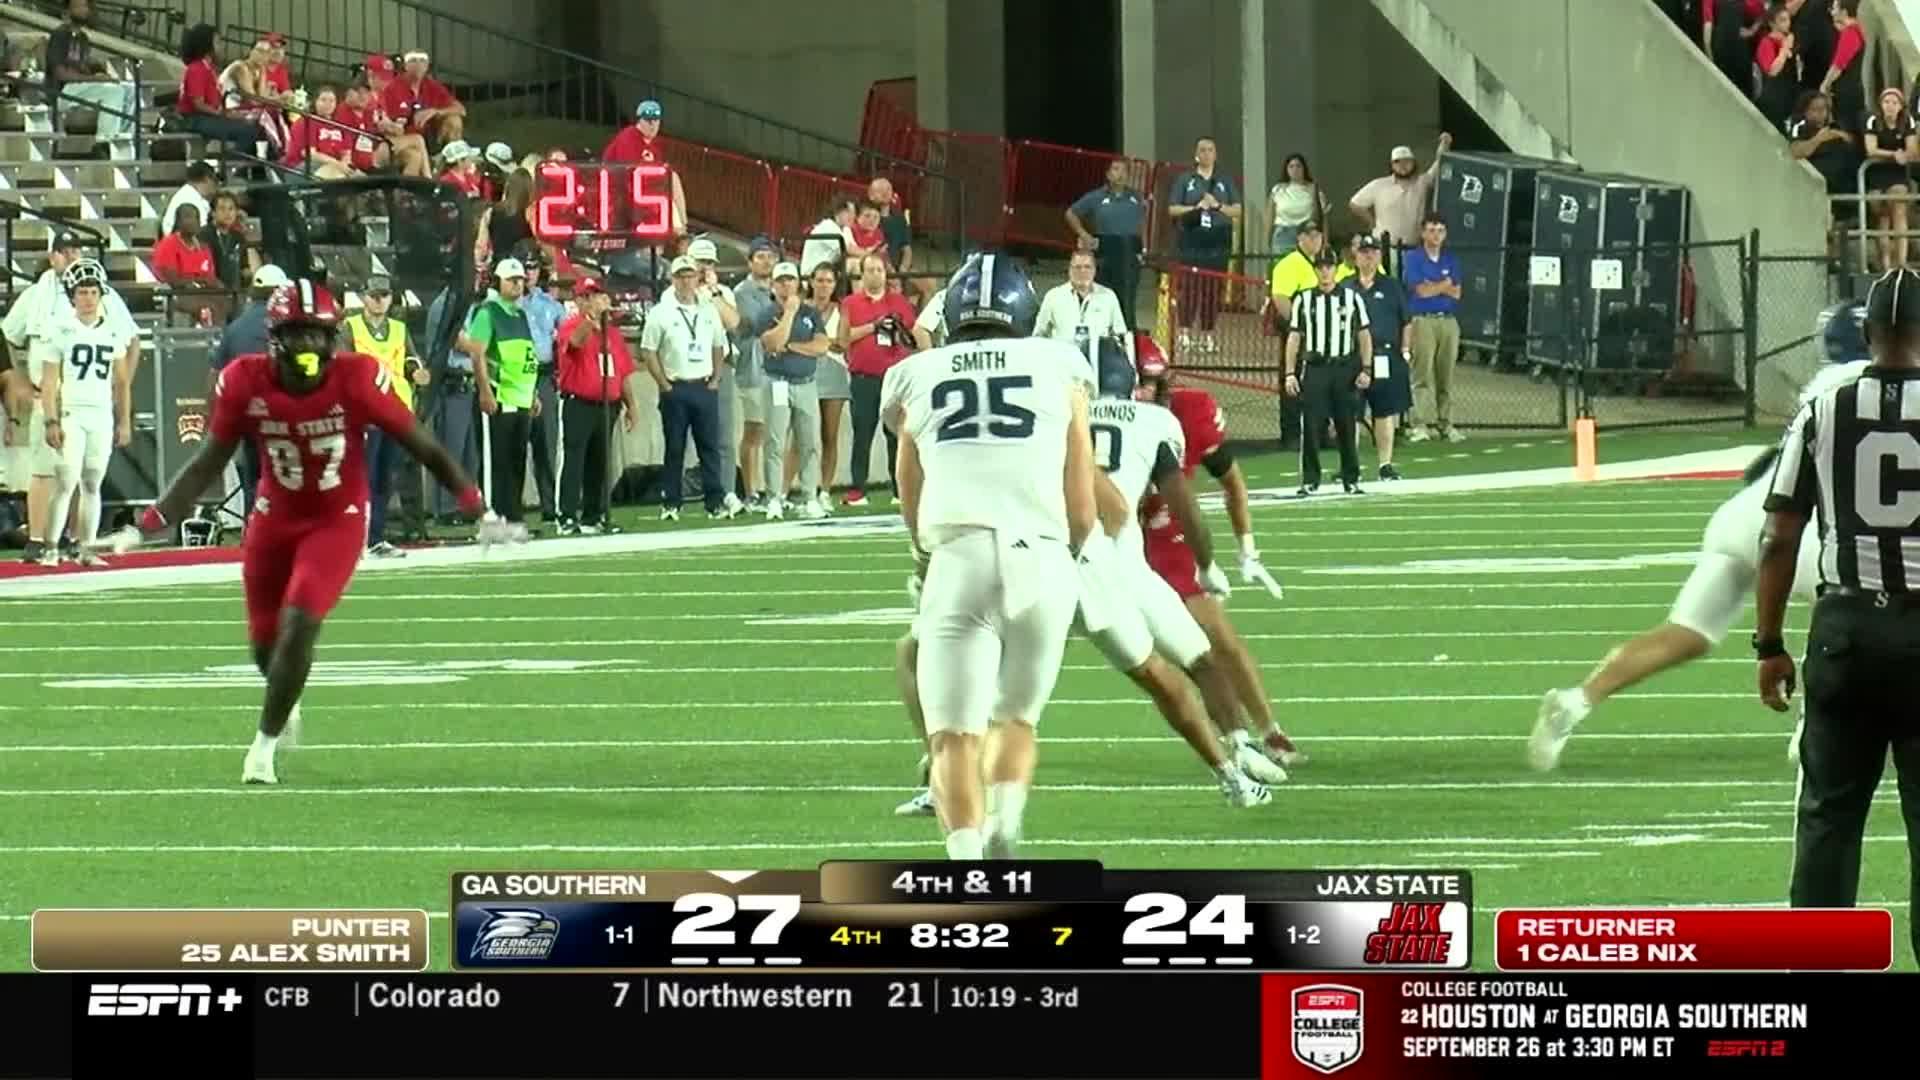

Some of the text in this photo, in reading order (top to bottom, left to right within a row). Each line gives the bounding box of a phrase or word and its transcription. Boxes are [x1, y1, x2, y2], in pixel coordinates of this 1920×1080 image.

[539, 166, 669, 235] 2:15
[71, 344, 114, 380] 95
[951, 351, 1006, 373] SMITH
[296, 416, 344, 435] STATE
[931, 375, 1036, 443] 25
[266, 433, 346, 491] 87
[1855, 431, 1920, 527] C
